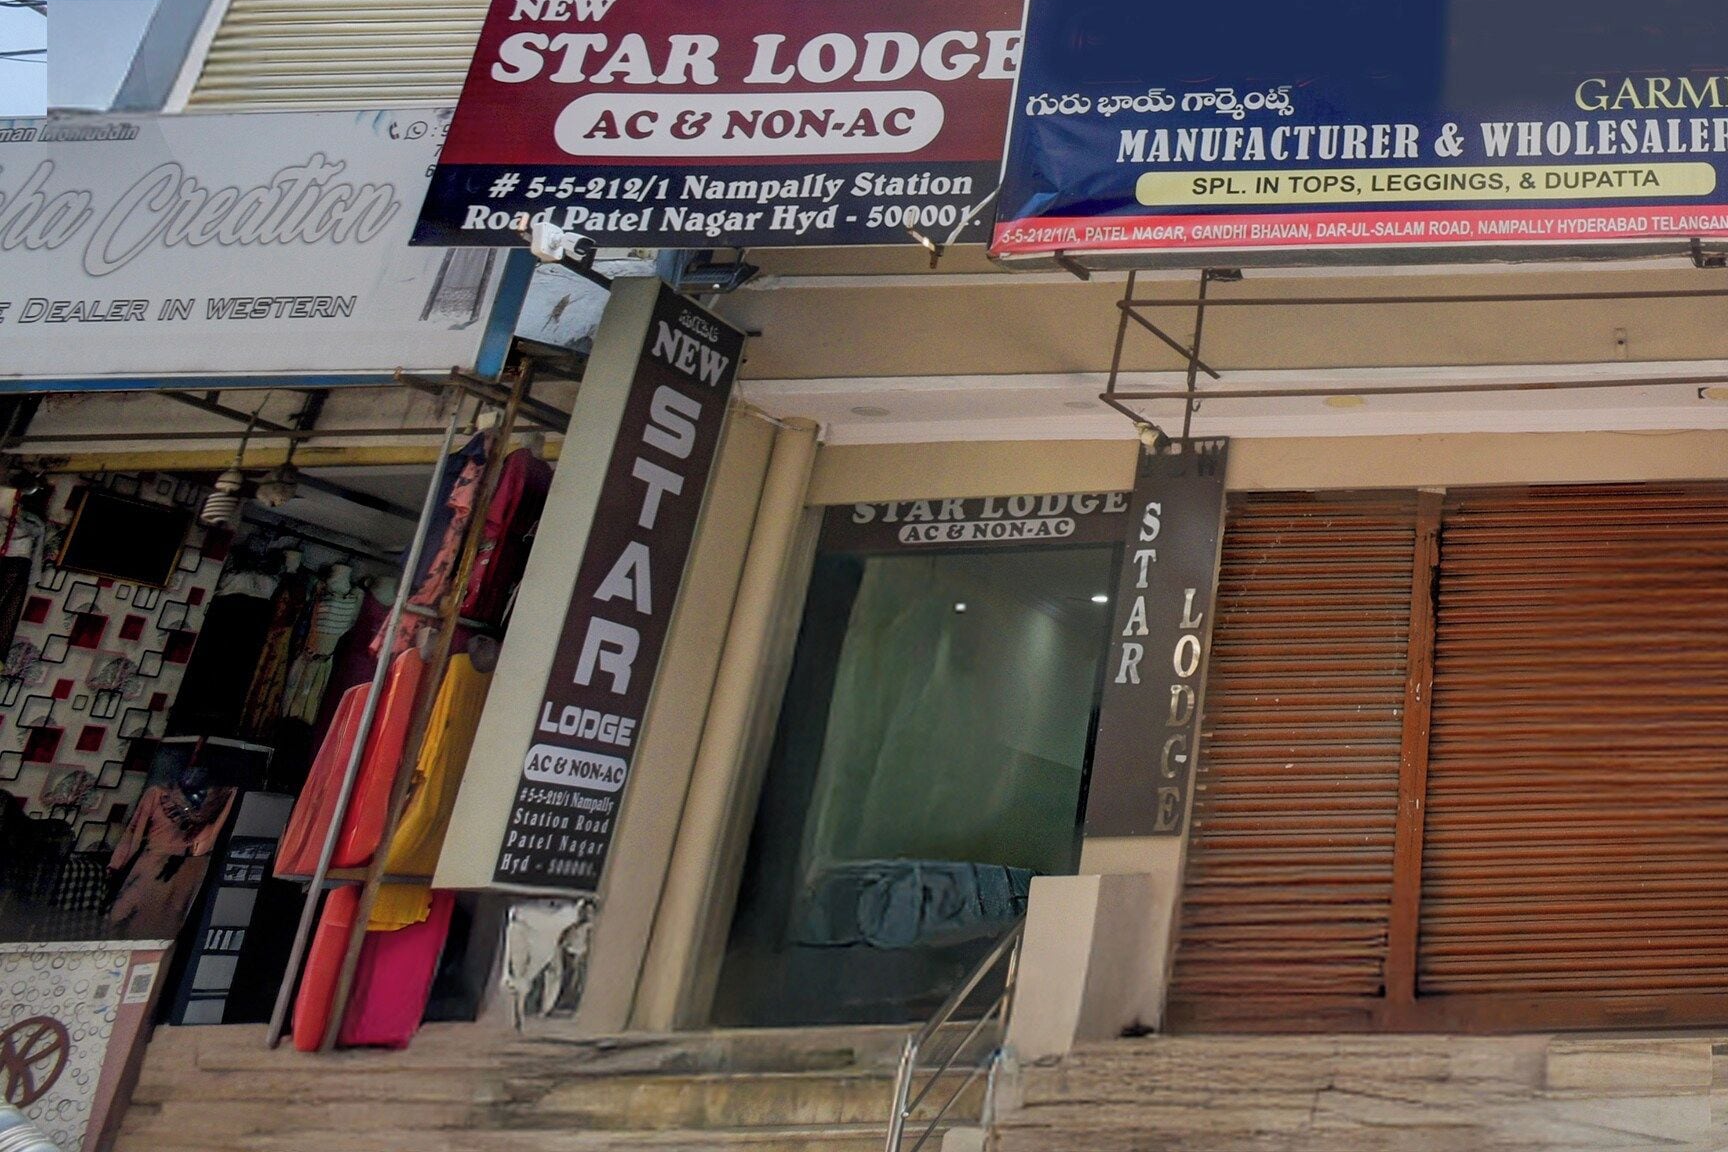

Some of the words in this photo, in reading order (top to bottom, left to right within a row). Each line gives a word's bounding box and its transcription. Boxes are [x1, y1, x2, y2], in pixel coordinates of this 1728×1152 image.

[491, 32, 718, 85] STAR
[744, 30, 1021, 85] LODGE
[1025, 93, 1091, 116] గురు
[584, 110, 657, 140] AC
[670, 111, 713, 139] &
[725, 107, 915, 139] NON-AC
[1116, 123, 1419, 164] MANUFACTURER
[1434, 122, 1464, 157] &
[487, 174, 521, 198] #
[525, 175, 668, 200] 5-5-212/1
[680, 172, 843, 203] Nampally
[850, 172, 972, 197] Station
[1192, 177, 1247, 196] SPL.
[1256, 176, 1279, 195] IN
[1288, 175, 1362, 196] TOPS,
[1372, 173, 1511, 194] LEGGINGS,
[1519, 173, 1536, 190] &
[1545, 170, 1660, 190] DUPATTA
[84, 152, 400, 277] Creation
[460, 205, 556, 230] Road
[562, 205, 652, 232] Patel
[660, 208, 760, 237] Nagar
[769, 204, 843, 235] Hyd
[1085, 227, 1129, 242] PATEL
[1131, 225, 1188, 244] NAGAR,
[1191, 224, 1247, 240] GANDHI
[1251, 222, 1313, 241] BHAVAN,
[1316, 220, 1426, 238] DAR-UL-SALAM
[1429, 220, 1475, 237] ROAD,
[1477, 218, 1555, 235] NAMPALLY
[1557, 216, 1647, 234] HYDERABAD
[19, 298, 147, 323] DEALER
[158, 298, 194, 322] IN
[206, 295, 357, 320] WESTERN
[652, 320, 729, 387] NEW
[852, 498, 966, 524] STAR
[980, 492, 1128, 519] LODGE
[574, 384, 702, 695] STAR
[904, 526, 940, 541] AC
[947, 524, 964, 539] &
[972, 520, 1070, 538] NON-AC
[1115, 502, 1161, 684] STAR
[539, 701, 636, 747] LODGE
[528, 753, 552, 772] AC
[554, 756, 568, 774] &
[568, 759, 624, 784] NON-AC
[570, 792, 614, 815] Nampally
[514, 808, 569, 829] Station
[576, 815, 609, 833] Road
[507, 830, 553, 850] Patel
[559, 836, 604, 857] Nagar
[501, 853, 531, 875] Hyd
